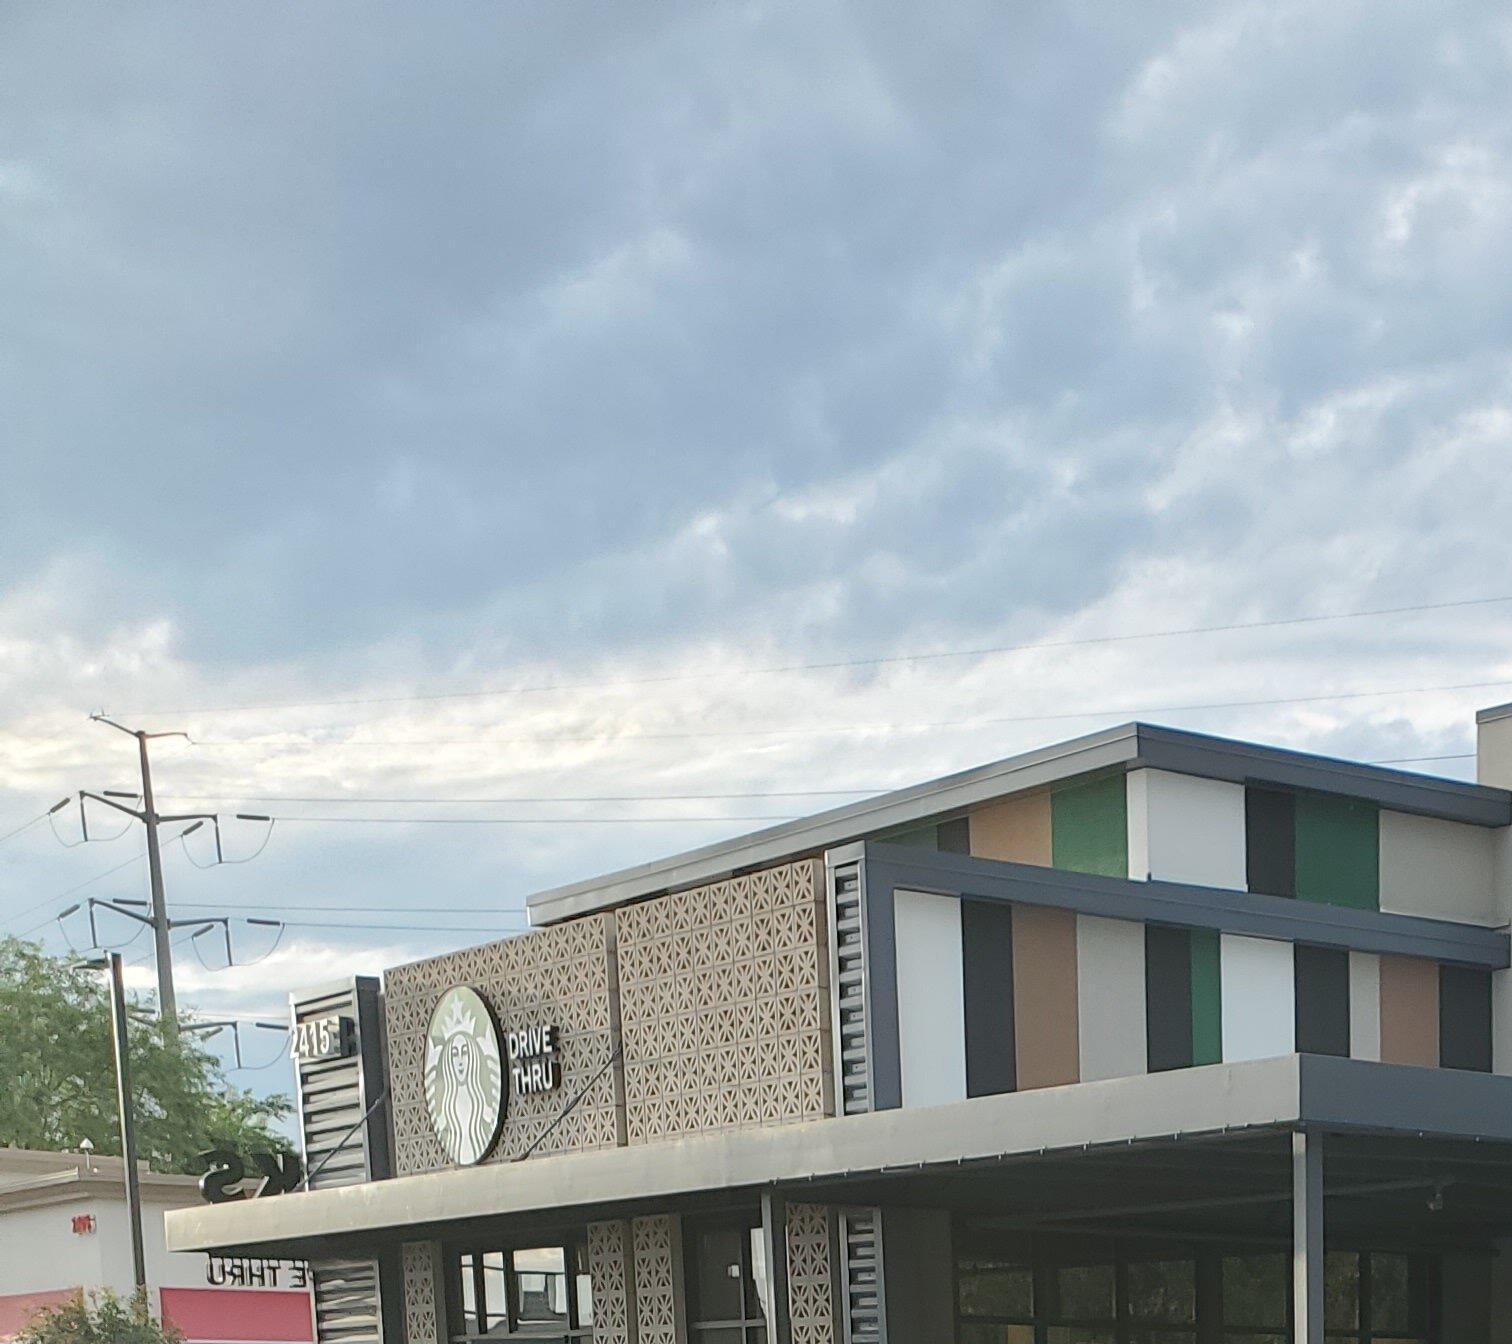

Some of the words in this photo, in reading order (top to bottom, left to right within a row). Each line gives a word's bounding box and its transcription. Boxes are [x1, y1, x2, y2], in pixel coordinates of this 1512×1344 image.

[289, 1018, 331, 1059] 2415
[508, 1024, 553, 1060] DRIVE
[512, 1059, 553, 1095] THRU
